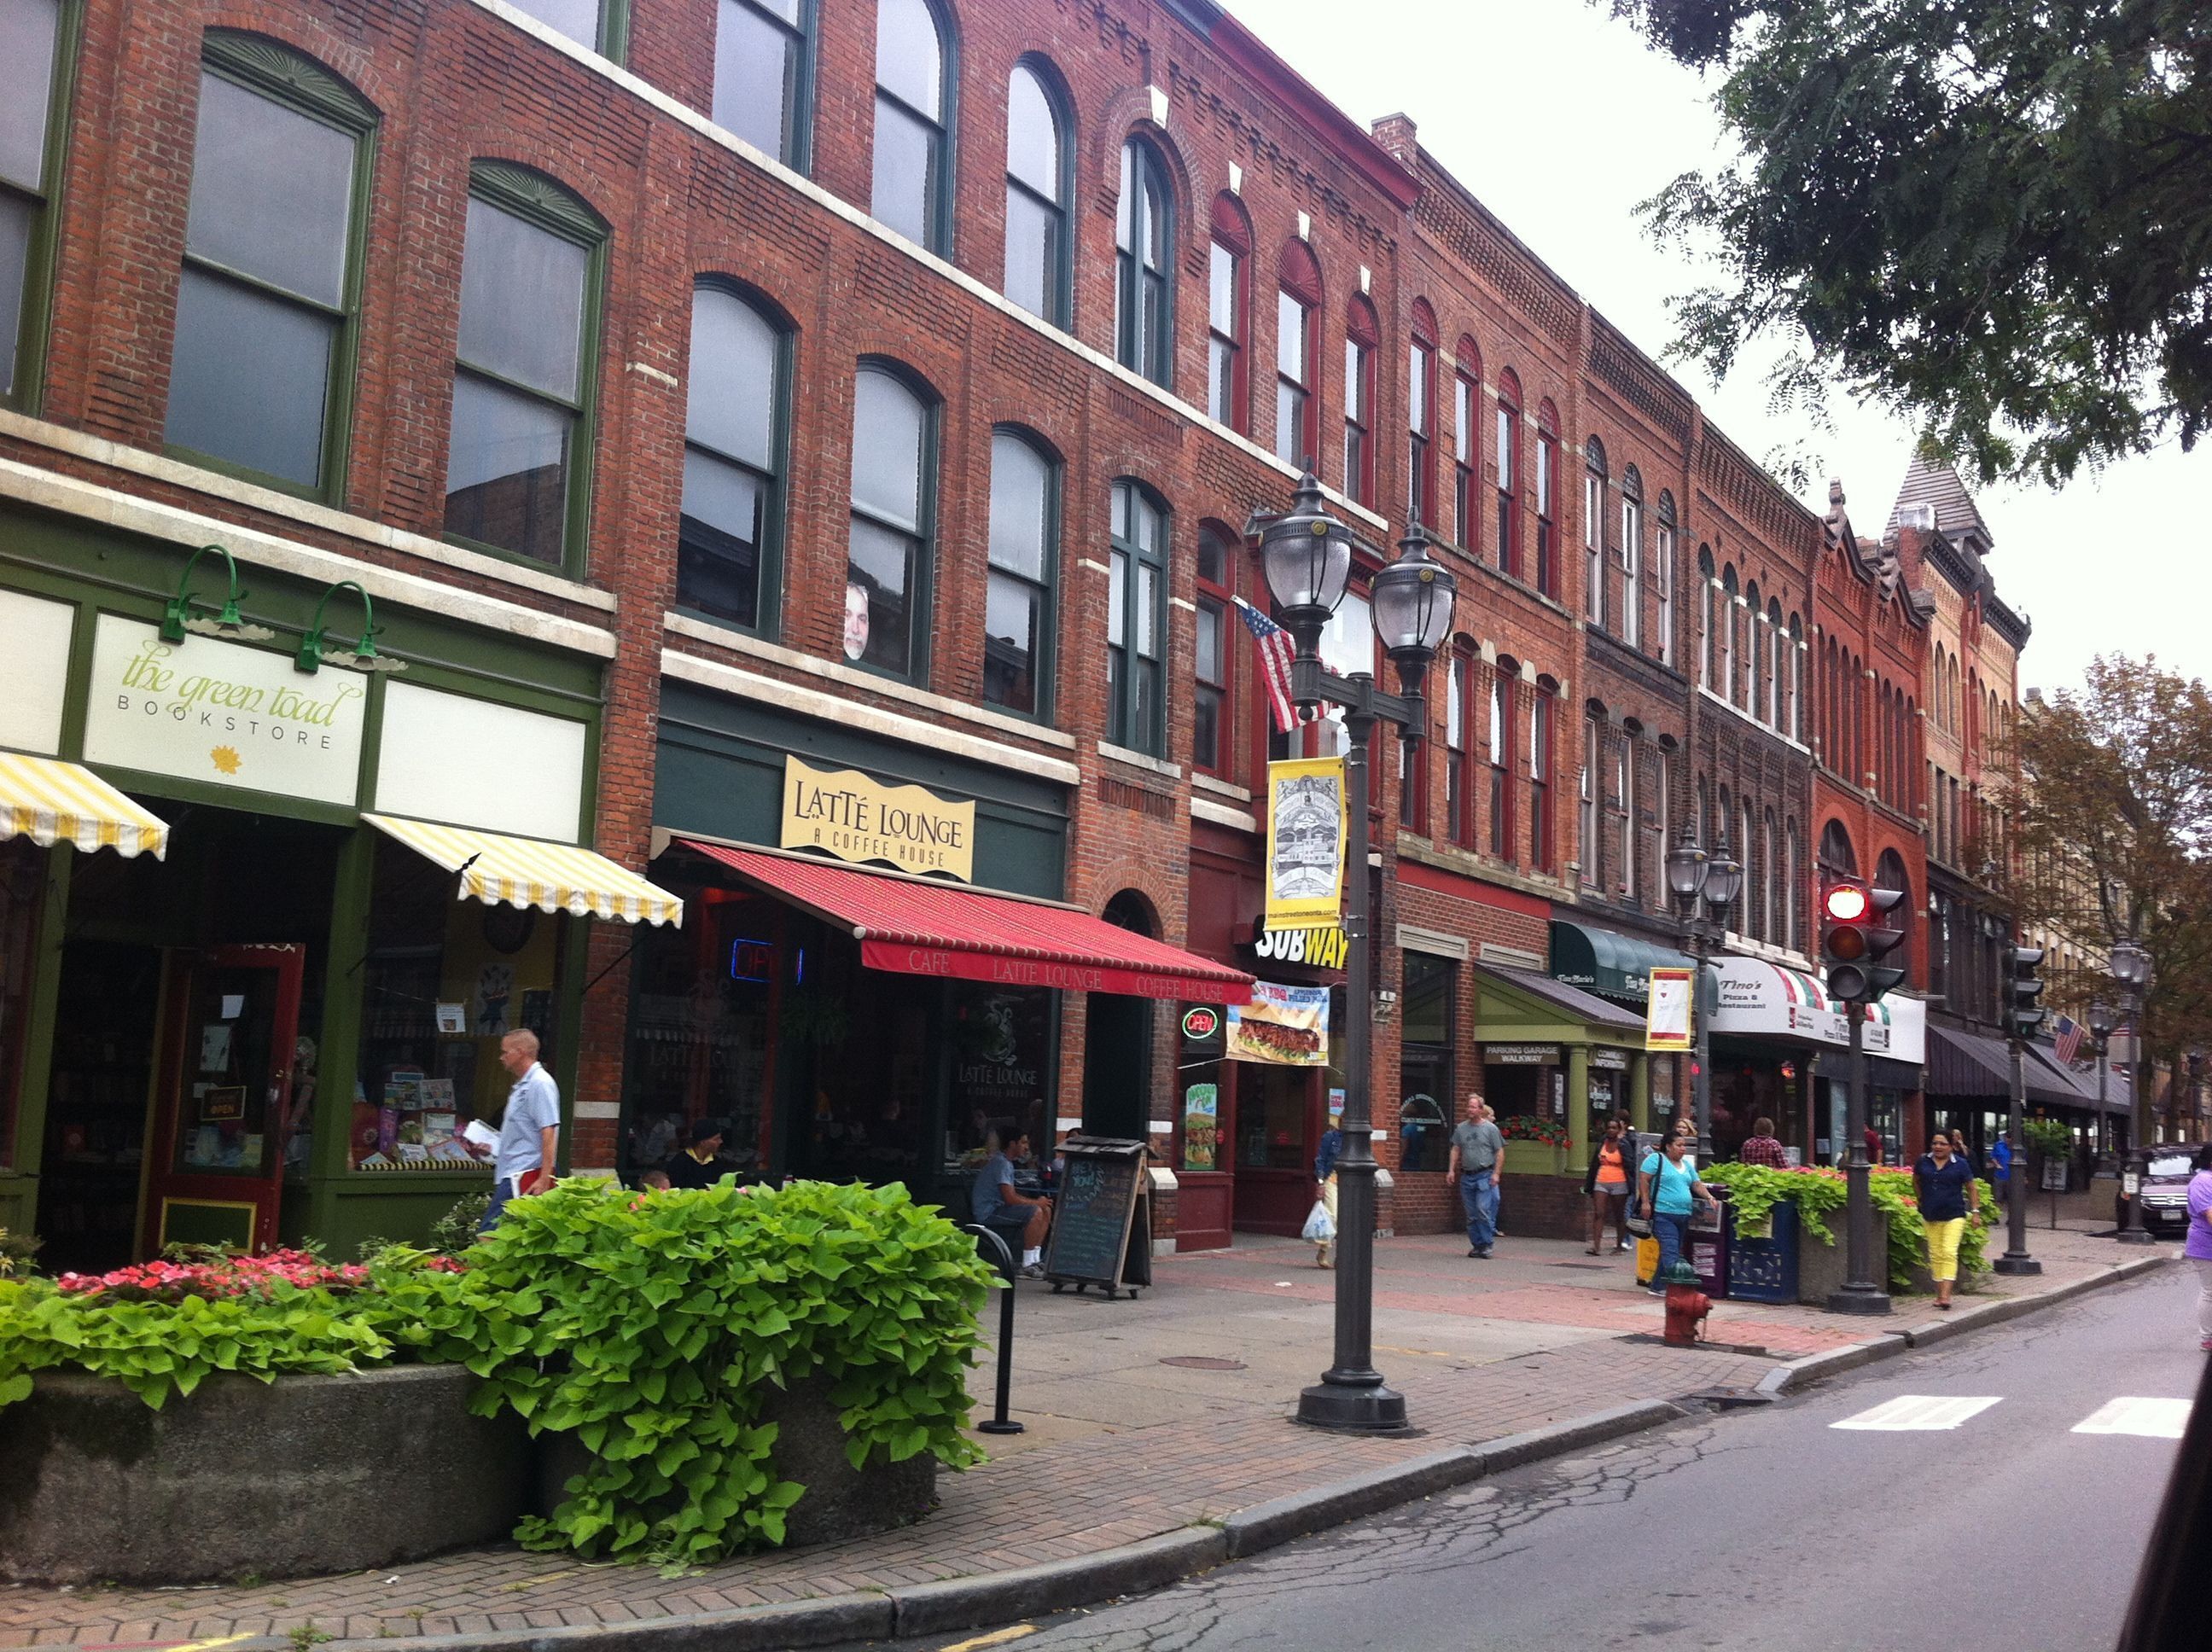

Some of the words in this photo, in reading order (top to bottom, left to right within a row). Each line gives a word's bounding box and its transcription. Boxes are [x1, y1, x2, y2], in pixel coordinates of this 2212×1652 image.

[122, 640, 173, 692] the
[166, 676, 265, 713] green
[269, 683, 364, 726] toad
[118, 695, 331, 749] BOOKSTORE
[795, 780, 869, 832] LATTÉ
[880, 803, 963, 848] LOUNGE
[814, 828, 820, 843] A
[833, 831, 888, 857] COFFEE
[899, 844, 944, 867] HOUSE
[1045, 964, 1103, 990] LOUNGE
[1136, 975, 1180, 998] COFFEE
[1185, 981, 1224, 1002] HOUSE
[1719, 980, 1762, 990] Tino's
[1187, 1014, 1214, 1031] OPEN
[1523, 1046, 1557, 1055] GARAGE
[997, 1067, 1037, 1085] LOUNGE
